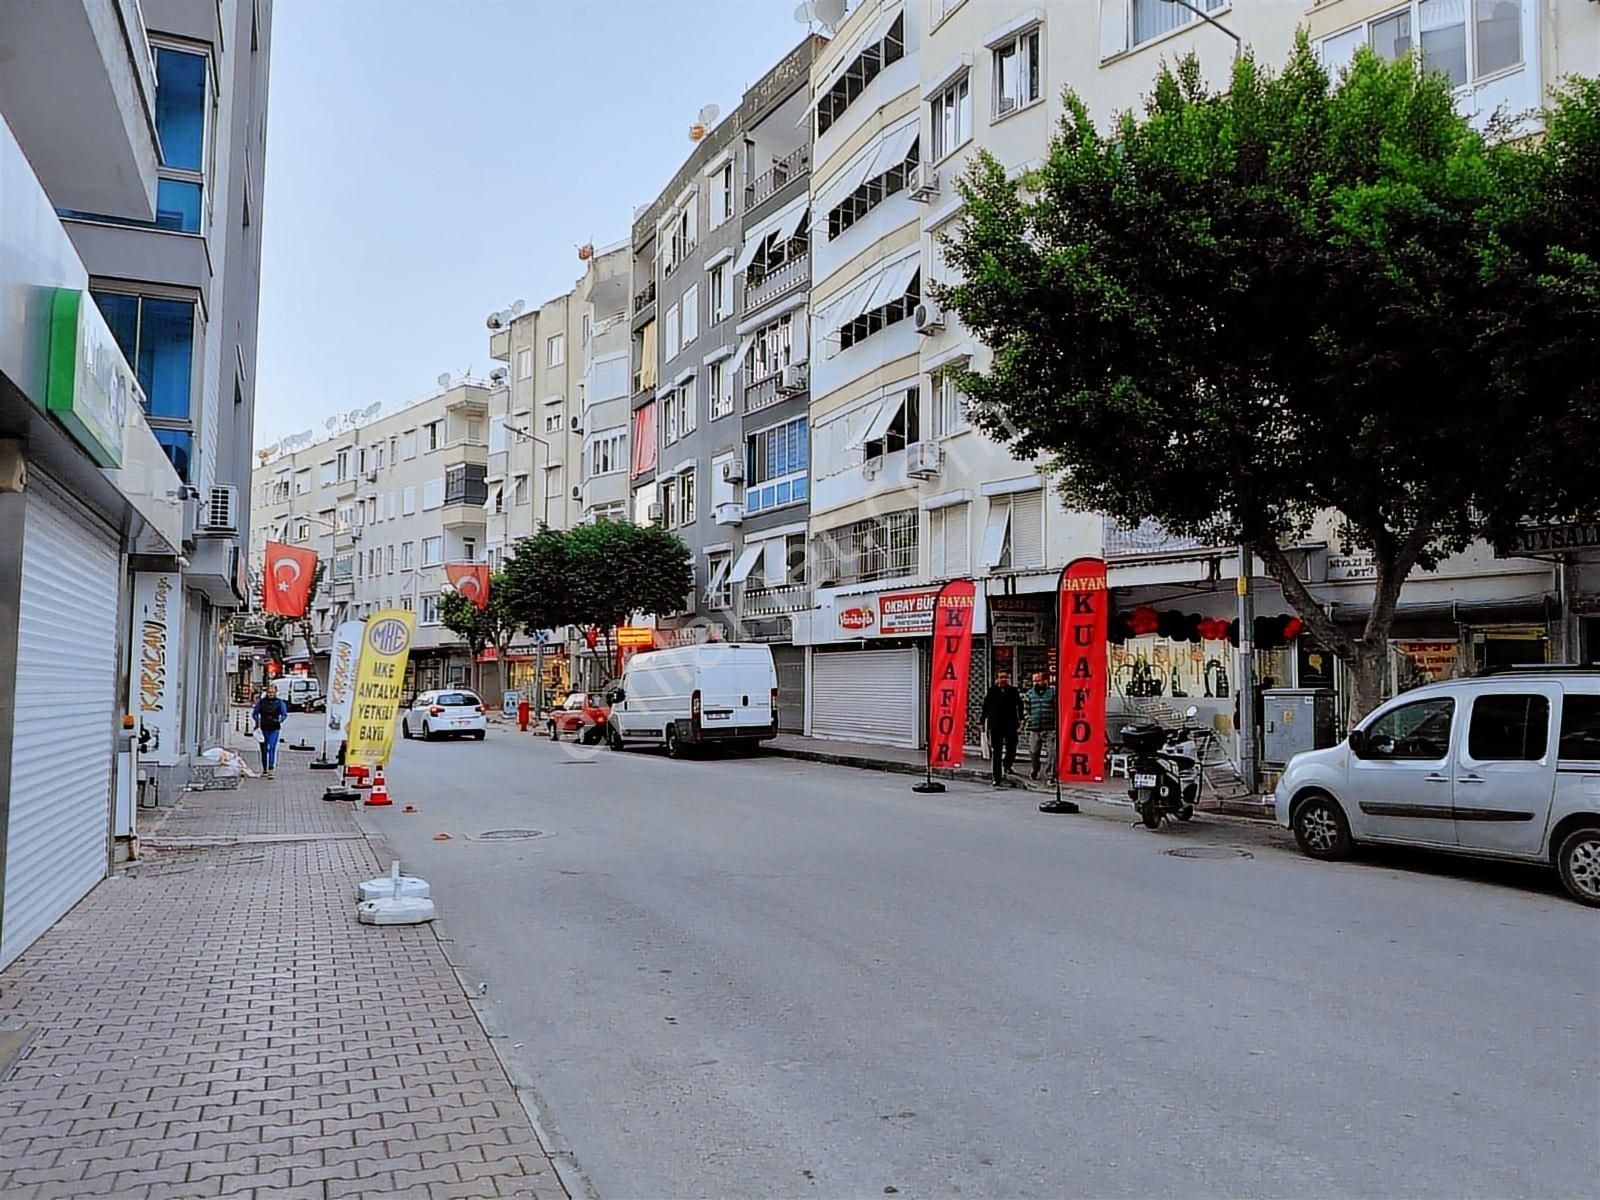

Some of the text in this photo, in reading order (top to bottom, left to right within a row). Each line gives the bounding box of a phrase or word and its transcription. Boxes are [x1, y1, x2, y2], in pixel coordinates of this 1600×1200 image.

[1063, 576, 1106, 591] BAYAN
[939, 596, 974, 608] BAYAN
[373, 620, 406, 652] MKE
[140, 620, 168, 713] KARACAN
[373, 662, 395, 678] MKE
[359, 683, 399, 700] ANTALYA
[936, 609, 964, 762] KUAFÖR
[1070, 593, 1094, 775] KUAFÖR
